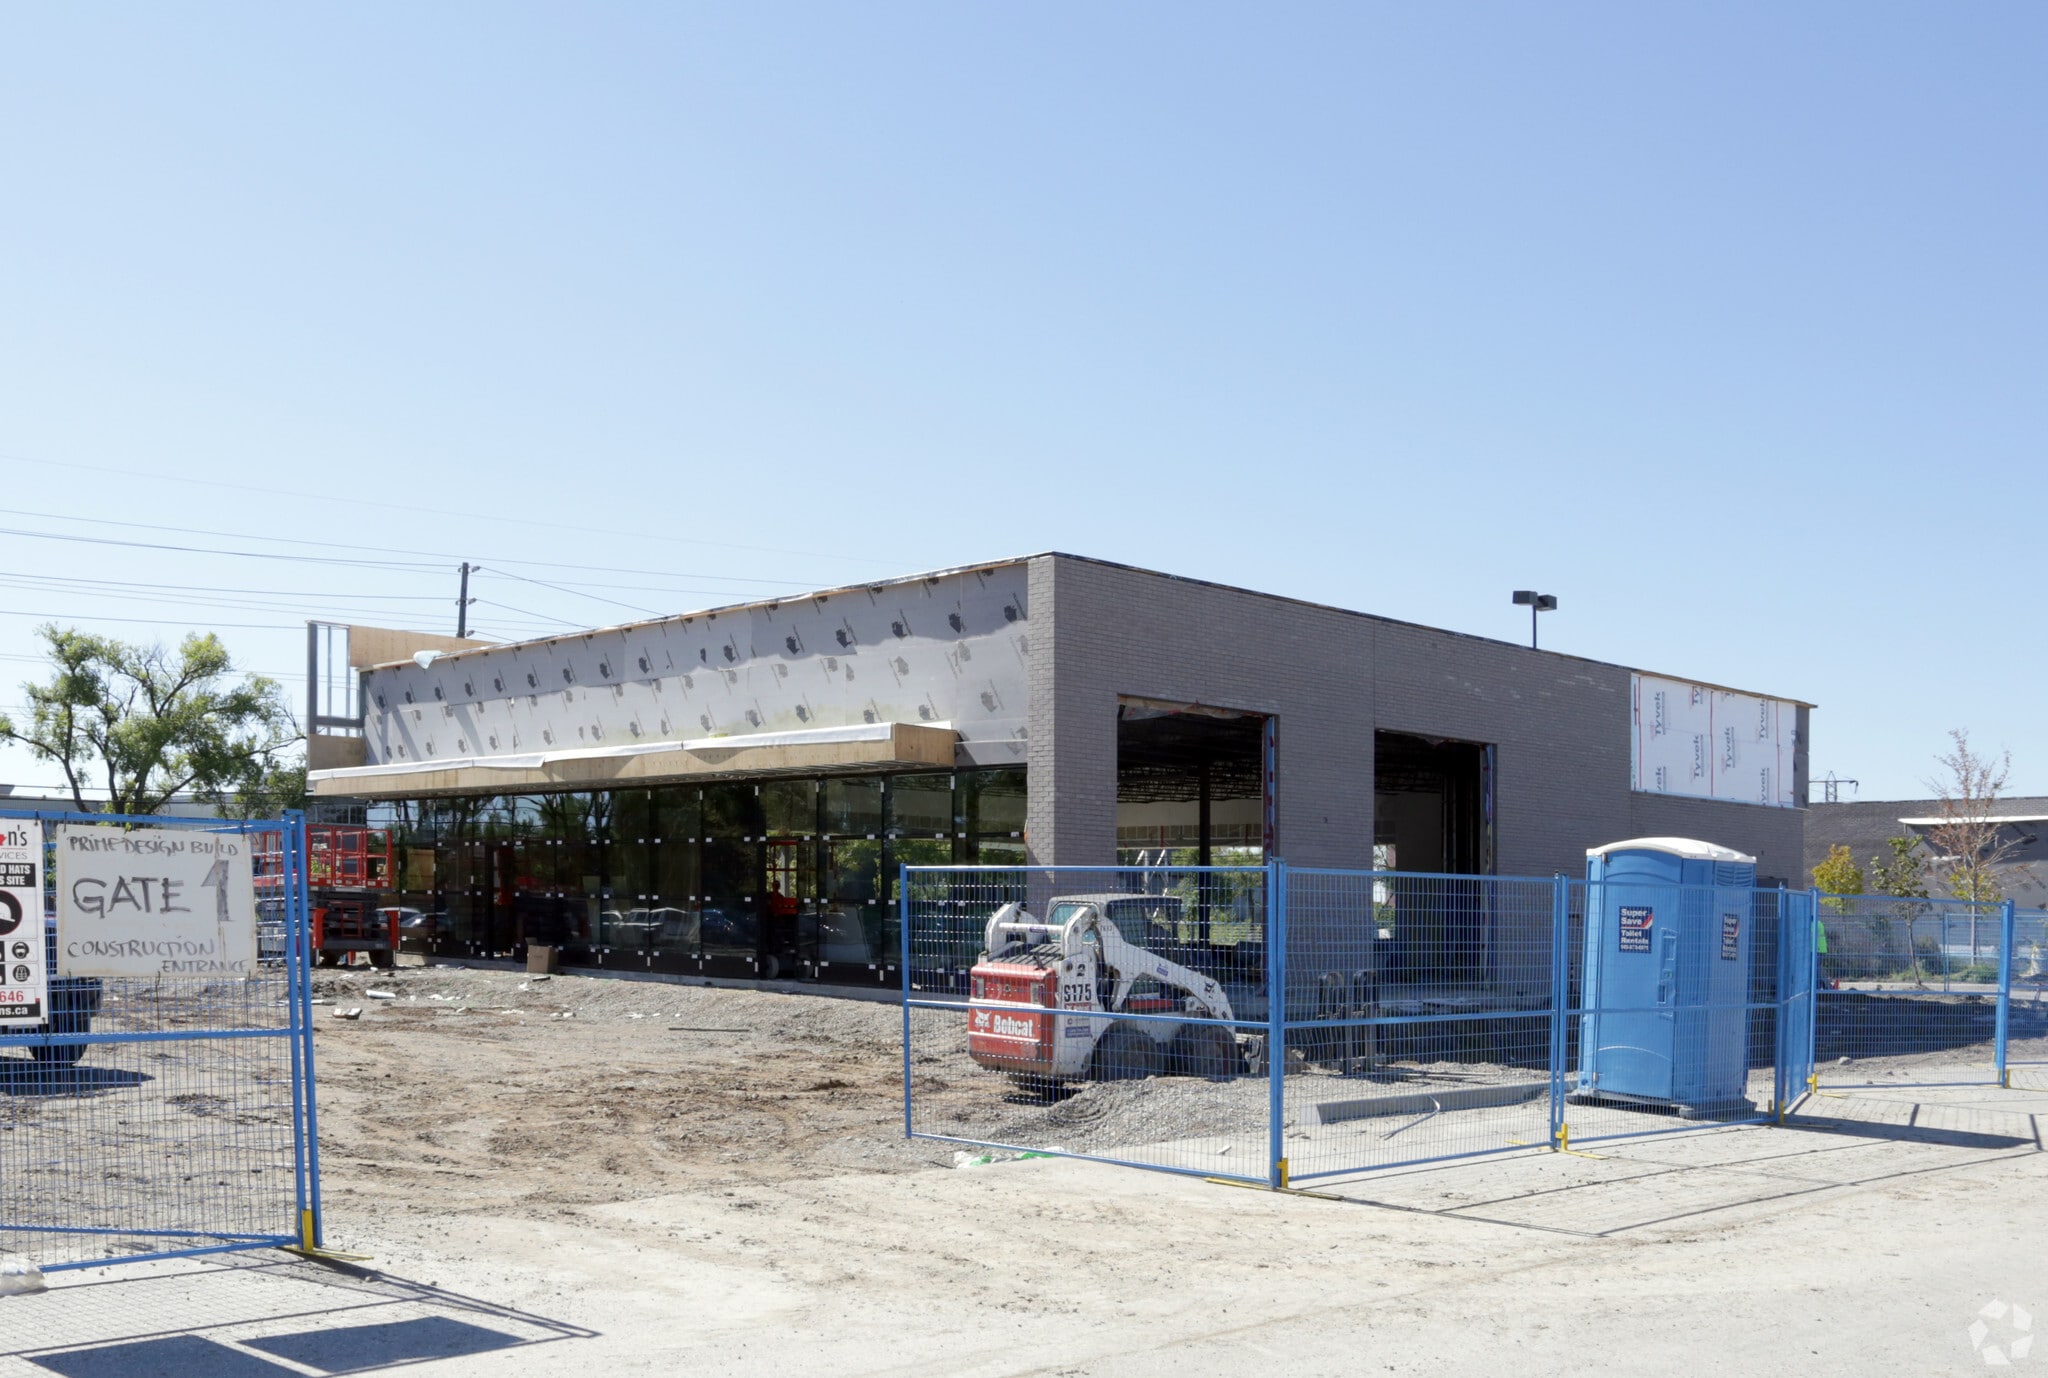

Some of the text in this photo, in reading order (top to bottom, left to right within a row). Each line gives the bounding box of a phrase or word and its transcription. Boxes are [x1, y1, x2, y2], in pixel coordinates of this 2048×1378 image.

[124, 835, 184, 857] DESIGN
[8, 864, 31, 874] HATS
[6, 875, 26, 885] SITE
[72, 859, 235, 922] GATE 1
[1621, 908, 1648, 918] Super
[1621, 917, 1643, 925] Save
[67, 935, 216, 958] CONSTRUCTION
[162, 959, 248, 974] ENTRANCE
[1063, 983, 1092, 1003] S175
[993, 1014, 1034, 1038] Bobcat
